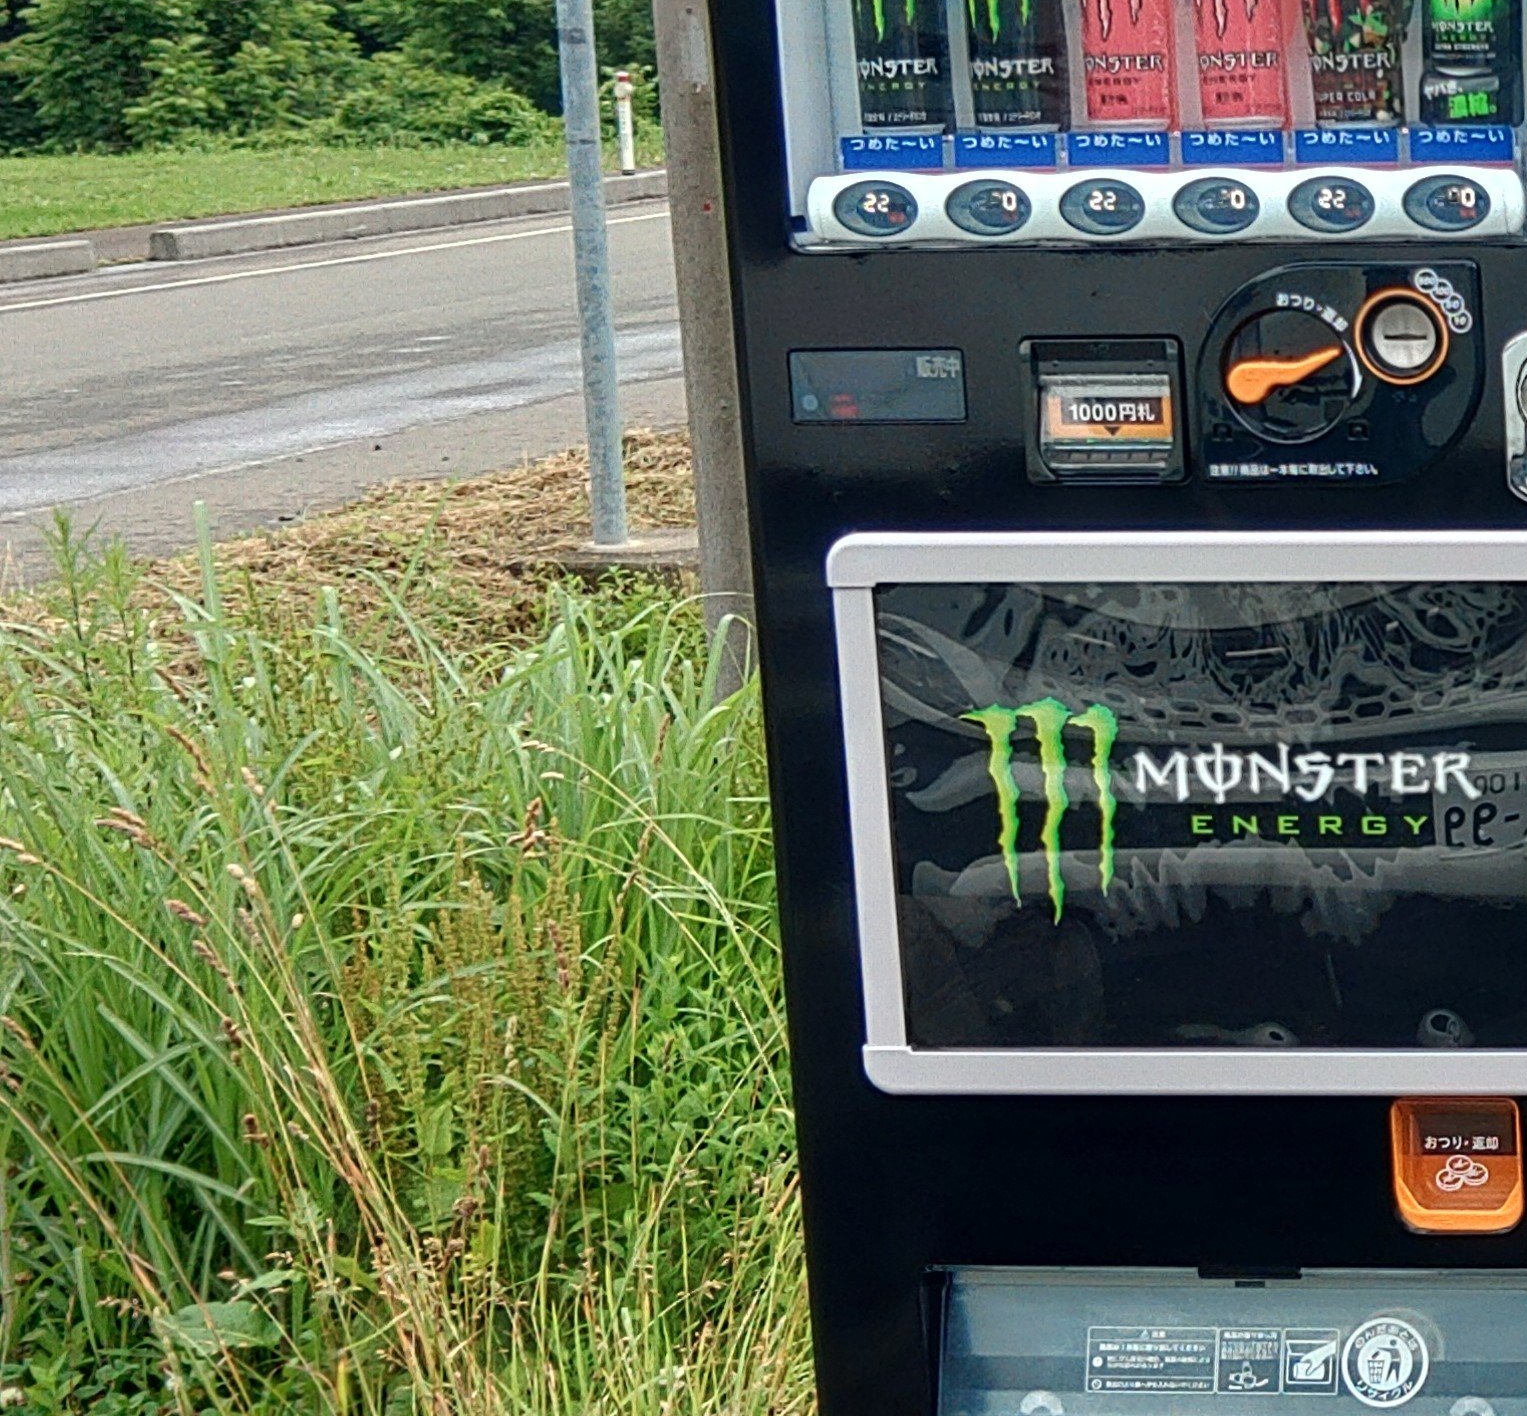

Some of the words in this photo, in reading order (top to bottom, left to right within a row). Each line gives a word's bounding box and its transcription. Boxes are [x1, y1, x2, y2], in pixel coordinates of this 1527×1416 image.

[1067, 401, 1157, 424] 1000円札
[1132, 740, 1481, 804] MONSTER
[1189, 813, 1429, 836] ENERGY
